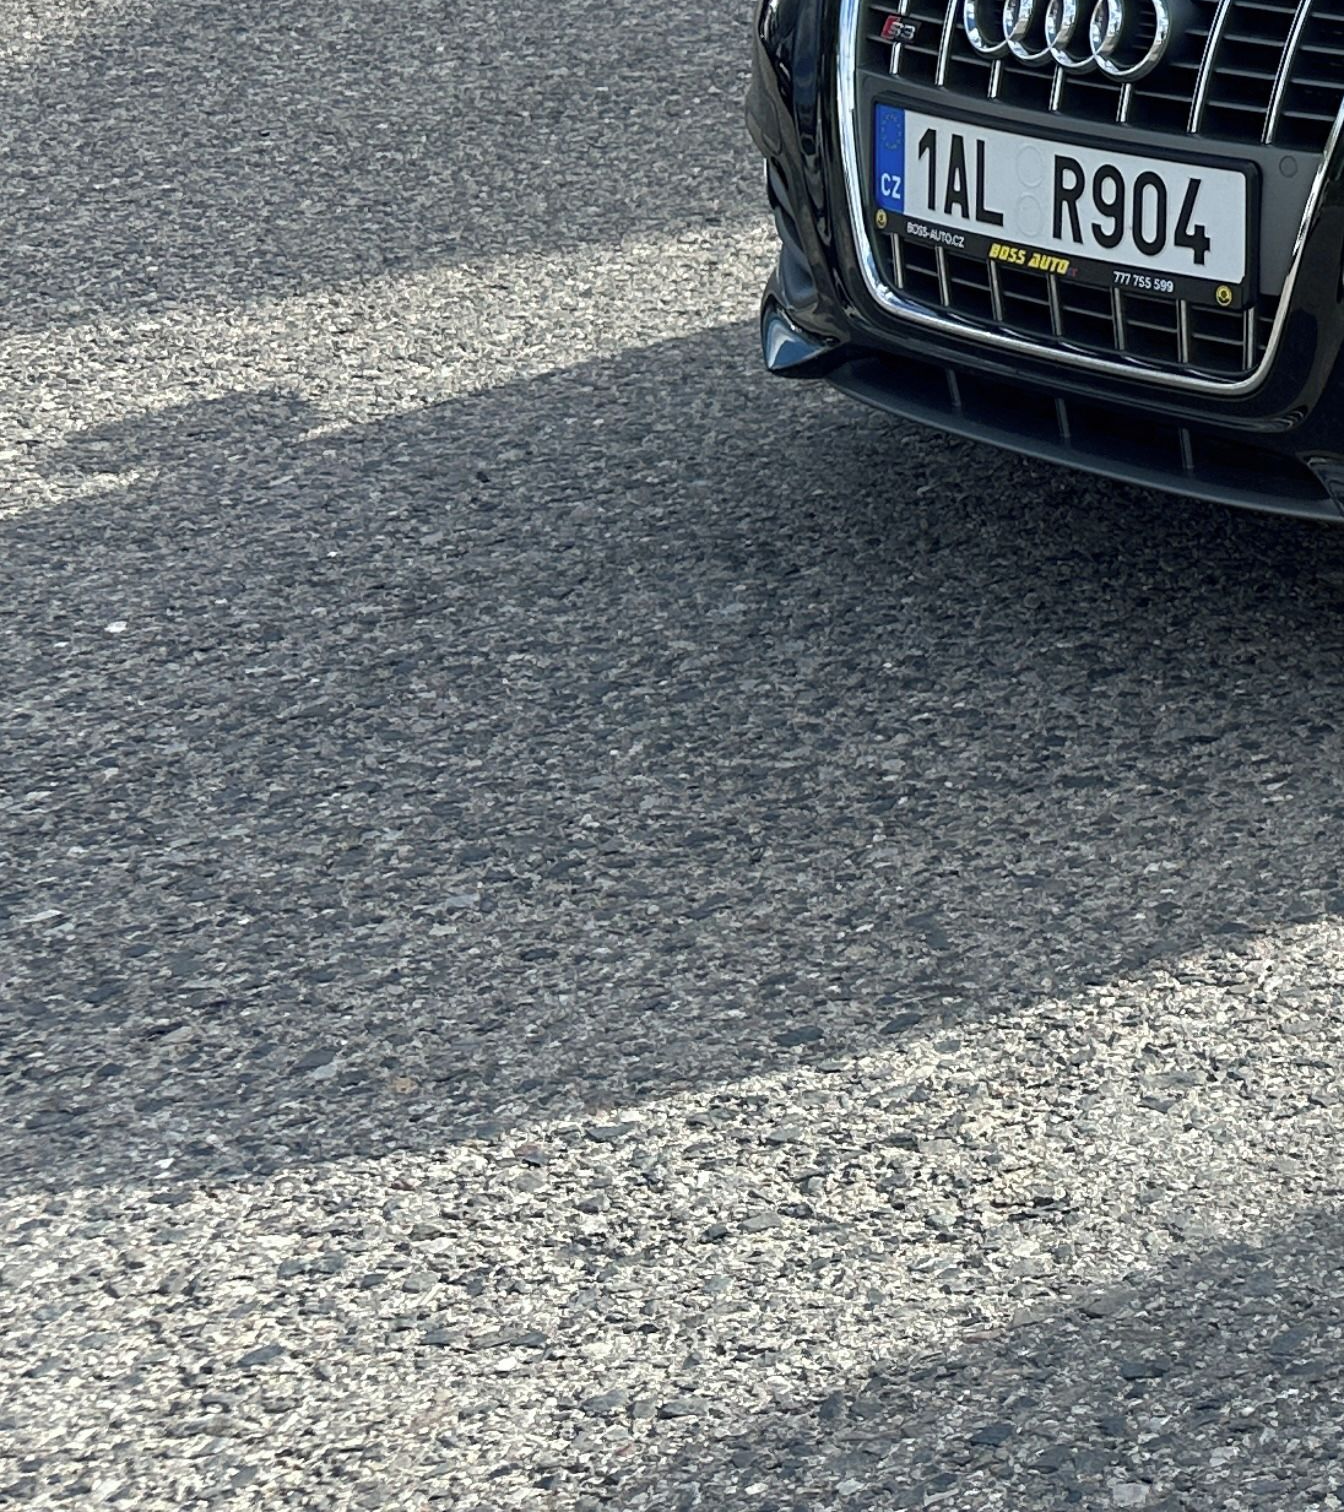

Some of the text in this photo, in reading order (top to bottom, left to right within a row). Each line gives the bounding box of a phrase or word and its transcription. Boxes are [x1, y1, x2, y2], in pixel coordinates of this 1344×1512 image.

[886, 21, 916, 41] S3
[881, 173, 901, 199] CZ
[918, 127, 1210, 265] 1AL R904
[906, 221, 965, 248] BOSS-AUTO.CZ
[989, 242, 1026, 265] BOSS
[1028, 252, 1070, 275] AUTO
[1113, 271, 1174, 293] 777 755 599
